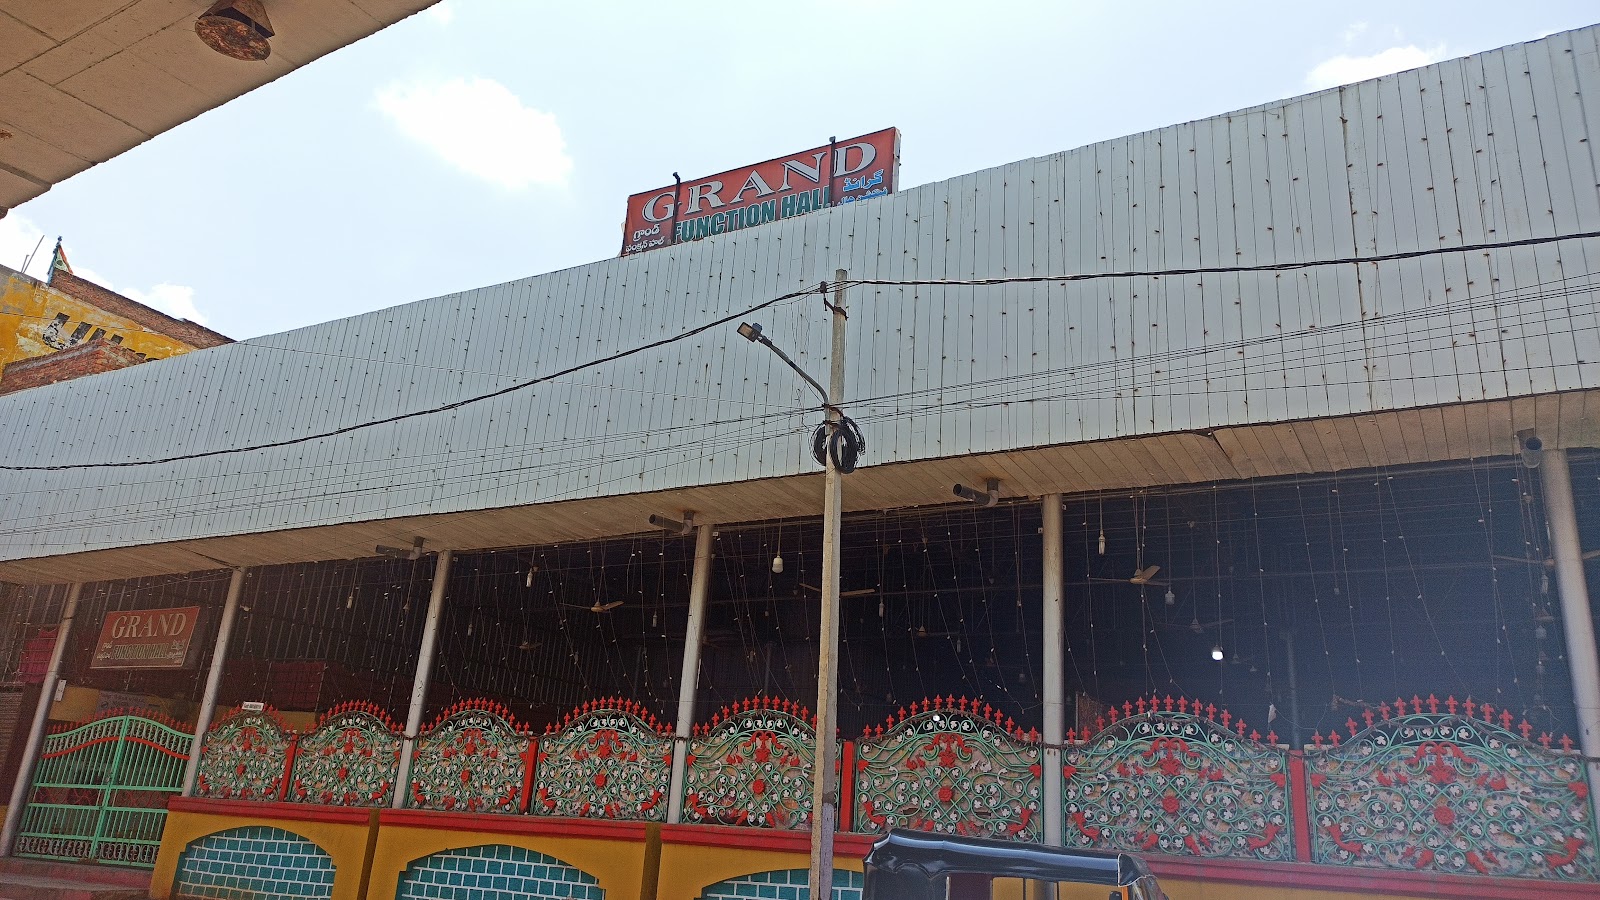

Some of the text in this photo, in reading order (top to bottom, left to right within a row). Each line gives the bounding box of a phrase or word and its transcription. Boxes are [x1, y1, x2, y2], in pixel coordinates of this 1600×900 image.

[642, 142, 877, 223] GRAND
[843, 169, 884, 192] گرانڈ
[673, 203, 776, 244] FUNCTION
[112, 613, 187, 639] GRAND
